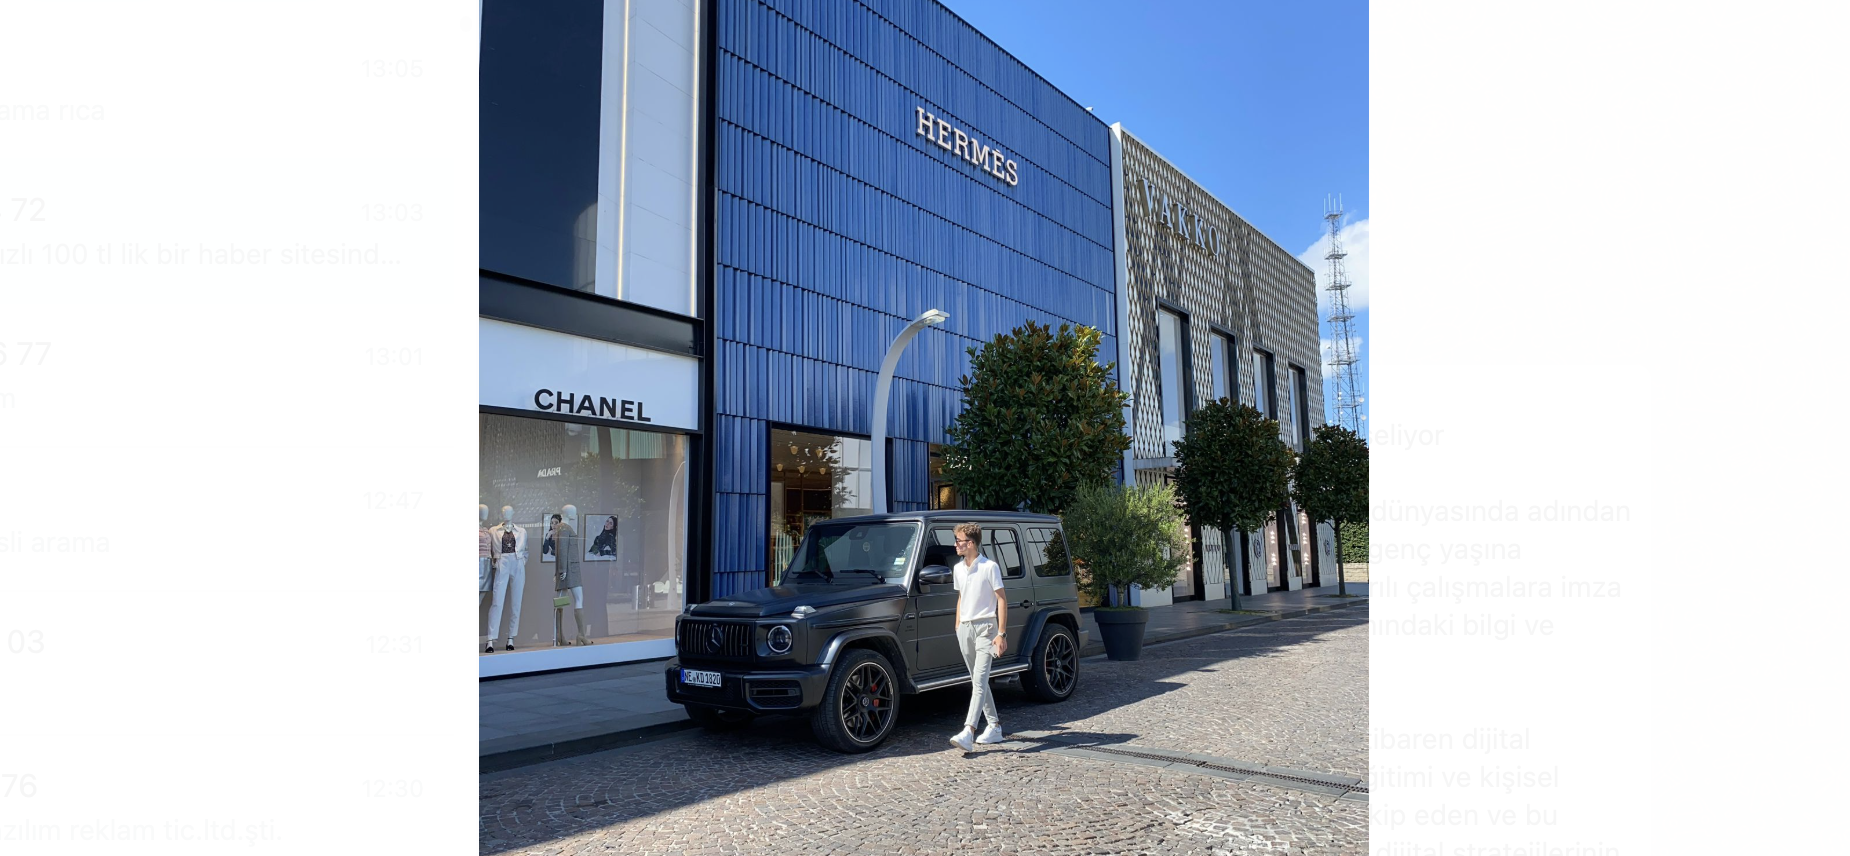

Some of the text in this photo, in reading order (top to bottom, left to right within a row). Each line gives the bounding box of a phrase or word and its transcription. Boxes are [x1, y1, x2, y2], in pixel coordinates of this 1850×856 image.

[363, 60, 423, 77] 13:05
[59, 104, 104, 121] rıca
[12, 198, 46, 221] 72
[362, 204, 423, 221] 13:03
[1139, 177, 1220, 256] VAKKO
[42, 243, 88, 264] 100
[96, 243, 111, 264] tl
[122, 243, 149, 264] lik
[157, 243, 190, 264] bir
[199, 243, 272, 264] haber
[17, 342, 51, 365] 77
[366, 348, 422, 365] 13:01
[534, 388, 651, 422] CHANEL
[364, 492, 423, 509] 12:47
[1372, 500, 1630, 527] dünyasında adından
[31, 536, 109, 553] arama
[1369, 543, 1521, 567] genç yaşına
[1406, 576, 1552, 604] çalışmalara
[1561, 576, 1621, 598] imza
[1464, 613, 1516, 641] bilgi
[1525, 619, 1554, 636] ve
[8, 630, 45, 653] 03
[367, 636, 422, 653] 12:31
[1462, 727, 1530, 755] dijital
[2, 774, 37, 797] 76
[363, 780, 423, 797] 12:30
[1442, 771, 1471, 788] ve
[1480, 765, 1558, 795] kişisel
[1414, 804, 1478, 826] eden
[1487, 809, 1517, 826] ve
[1526, 804, 1557, 826] bu
[0, 819, 282, 847] zılım reklam tic.ltd.şti.
